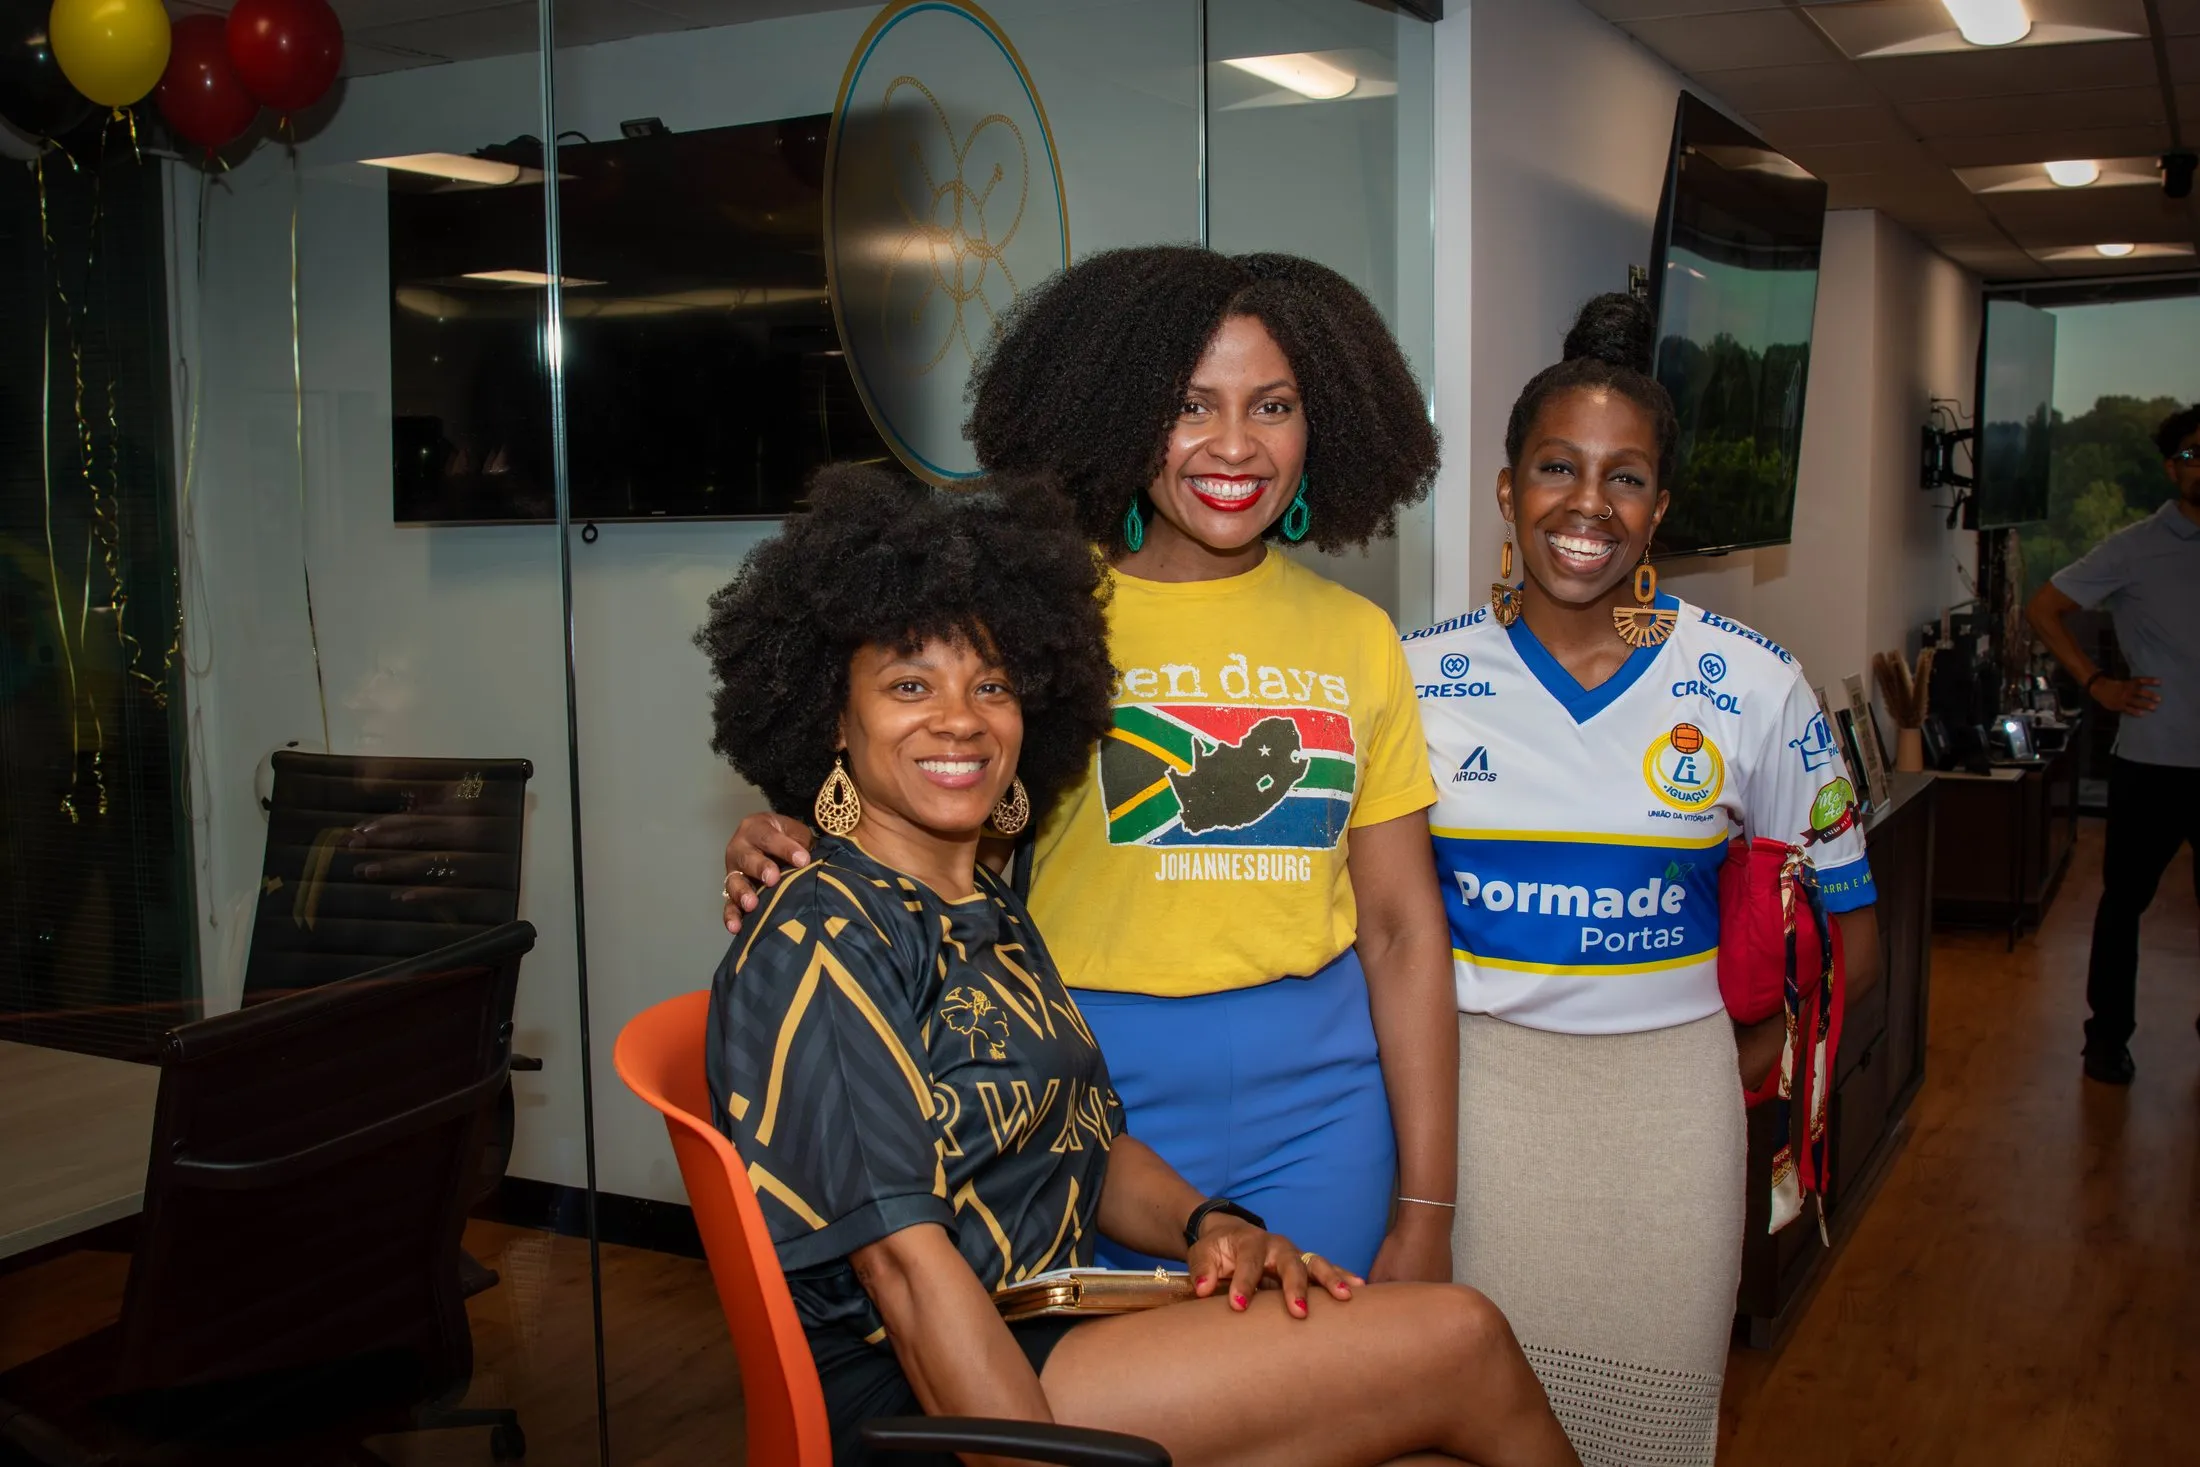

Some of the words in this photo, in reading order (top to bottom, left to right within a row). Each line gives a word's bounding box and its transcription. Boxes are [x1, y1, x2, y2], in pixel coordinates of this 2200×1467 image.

[1218, 653, 1350, 706] days
[1414, 681, 1497, 699] CRESOL
[1671, 680, 1742, 715] CRESOL
[1452, 771, 1498, 783] ARDOS
[1665, 785, 1708, 803] IGUAÇU
[1647, 809, 1671, 819] UNIÃO
[1672, 812, 1683, 820] DA
[1154, 853, 1311, 882] JOHANNESBURG
[1853, 878, 1859, 888] E
[1454, 870, 1686, 919] Pormade
[1580, 926, 1684, 953] Portas
